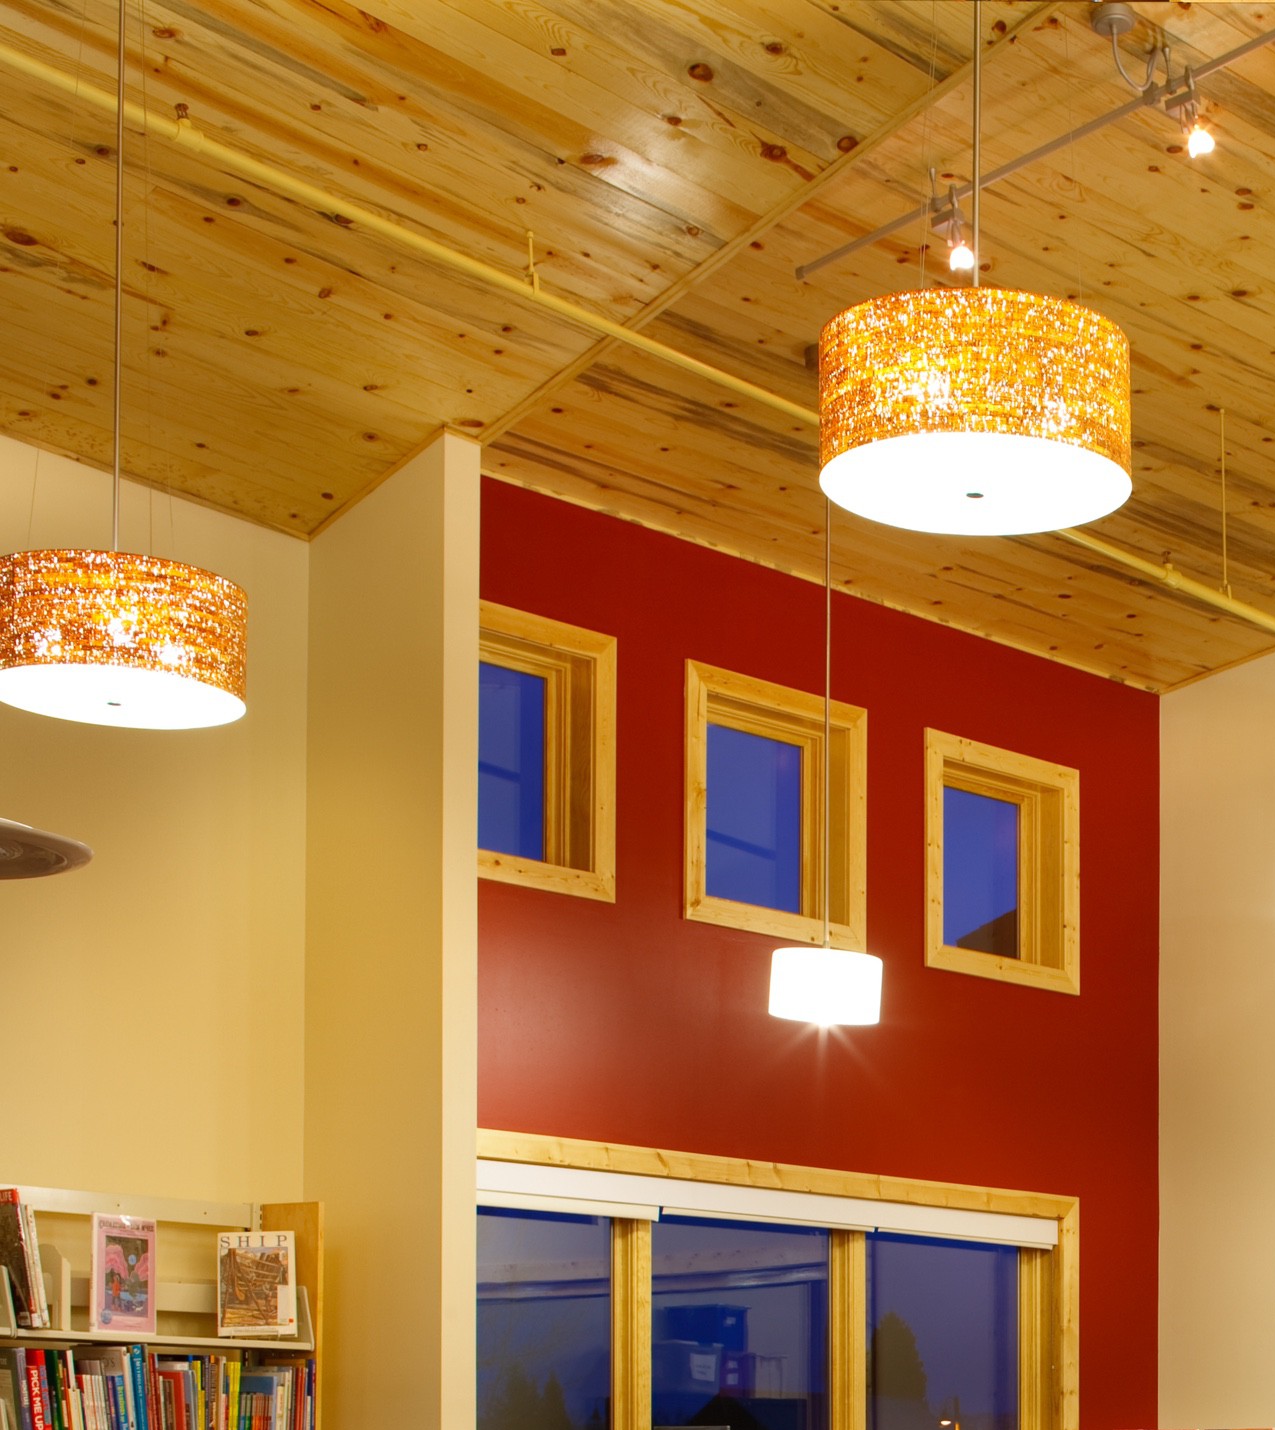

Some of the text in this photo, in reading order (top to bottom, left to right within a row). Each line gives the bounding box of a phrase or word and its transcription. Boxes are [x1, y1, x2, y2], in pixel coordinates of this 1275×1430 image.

[220, 1235, 288, 1248] SHIP
[30, 1370, 44, 1430] PICK ME UP
